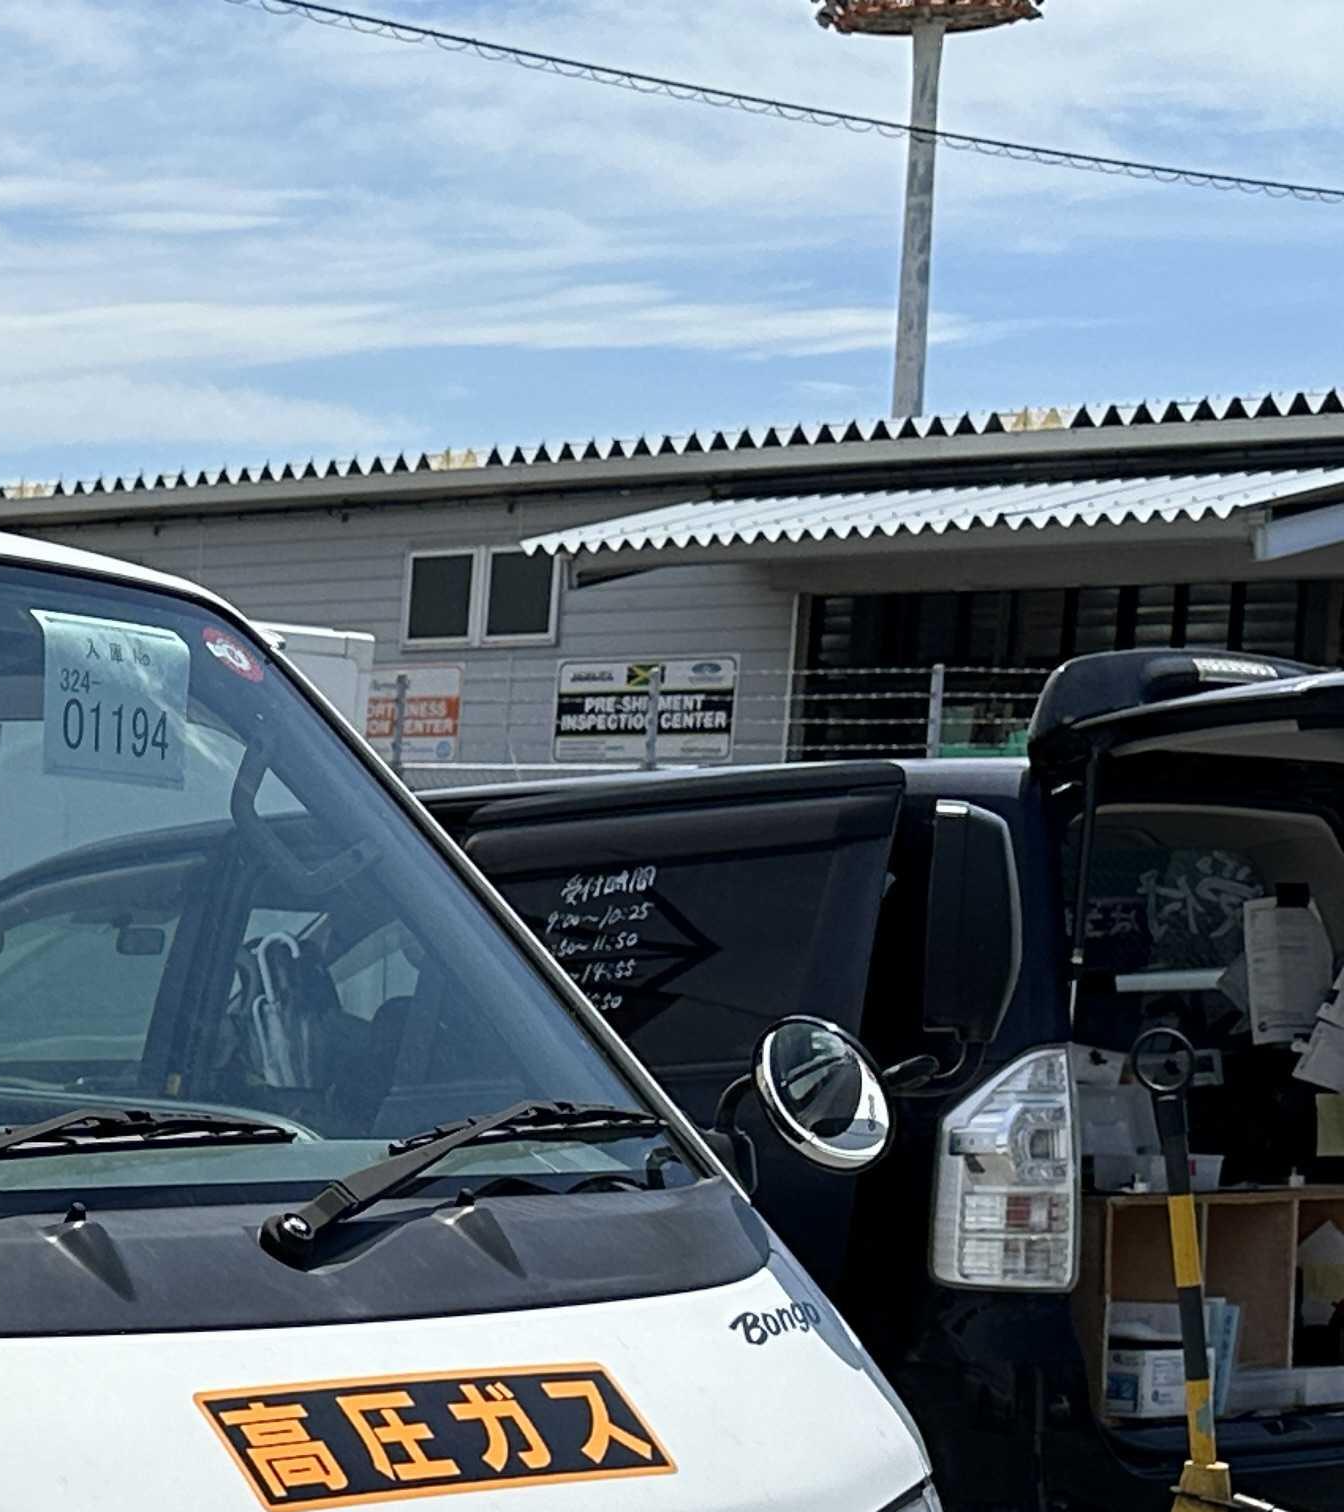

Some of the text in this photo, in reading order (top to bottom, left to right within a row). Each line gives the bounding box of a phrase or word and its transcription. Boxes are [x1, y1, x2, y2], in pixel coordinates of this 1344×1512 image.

[59, 667, 103, 694] 324-
[560, 711, 728, 732] INSPECTIO CENTER
[583, 694, 706, 714] PRE-SHIMENT
[62, 697, 169, 761] 01194
[729, 1298, 822, 1346] Bongo
[217, 1378, 654, 1497] 高圧ガス
